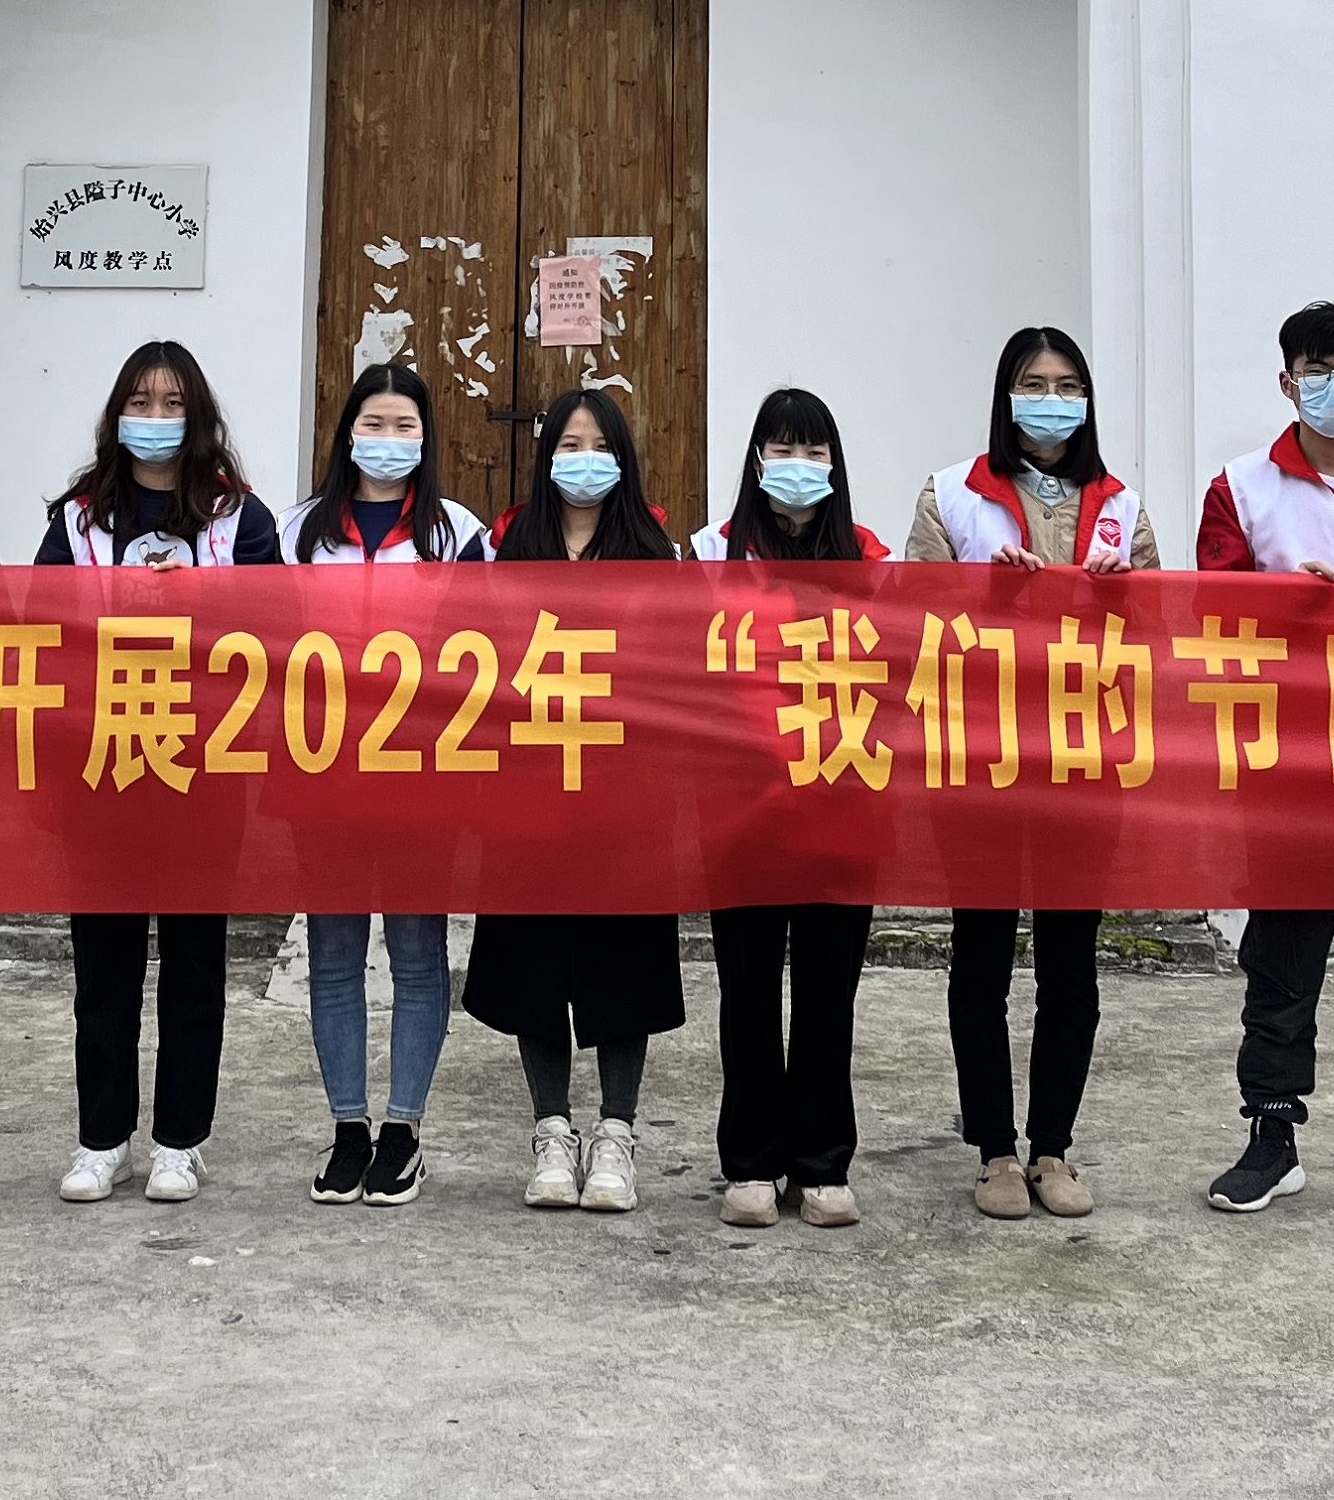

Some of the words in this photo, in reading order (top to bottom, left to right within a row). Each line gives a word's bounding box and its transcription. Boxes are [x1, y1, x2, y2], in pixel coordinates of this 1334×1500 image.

[29, 179, 200, 243] 始兴县隘子中心小学
[53, 250, 173, 271] 风度教学点
